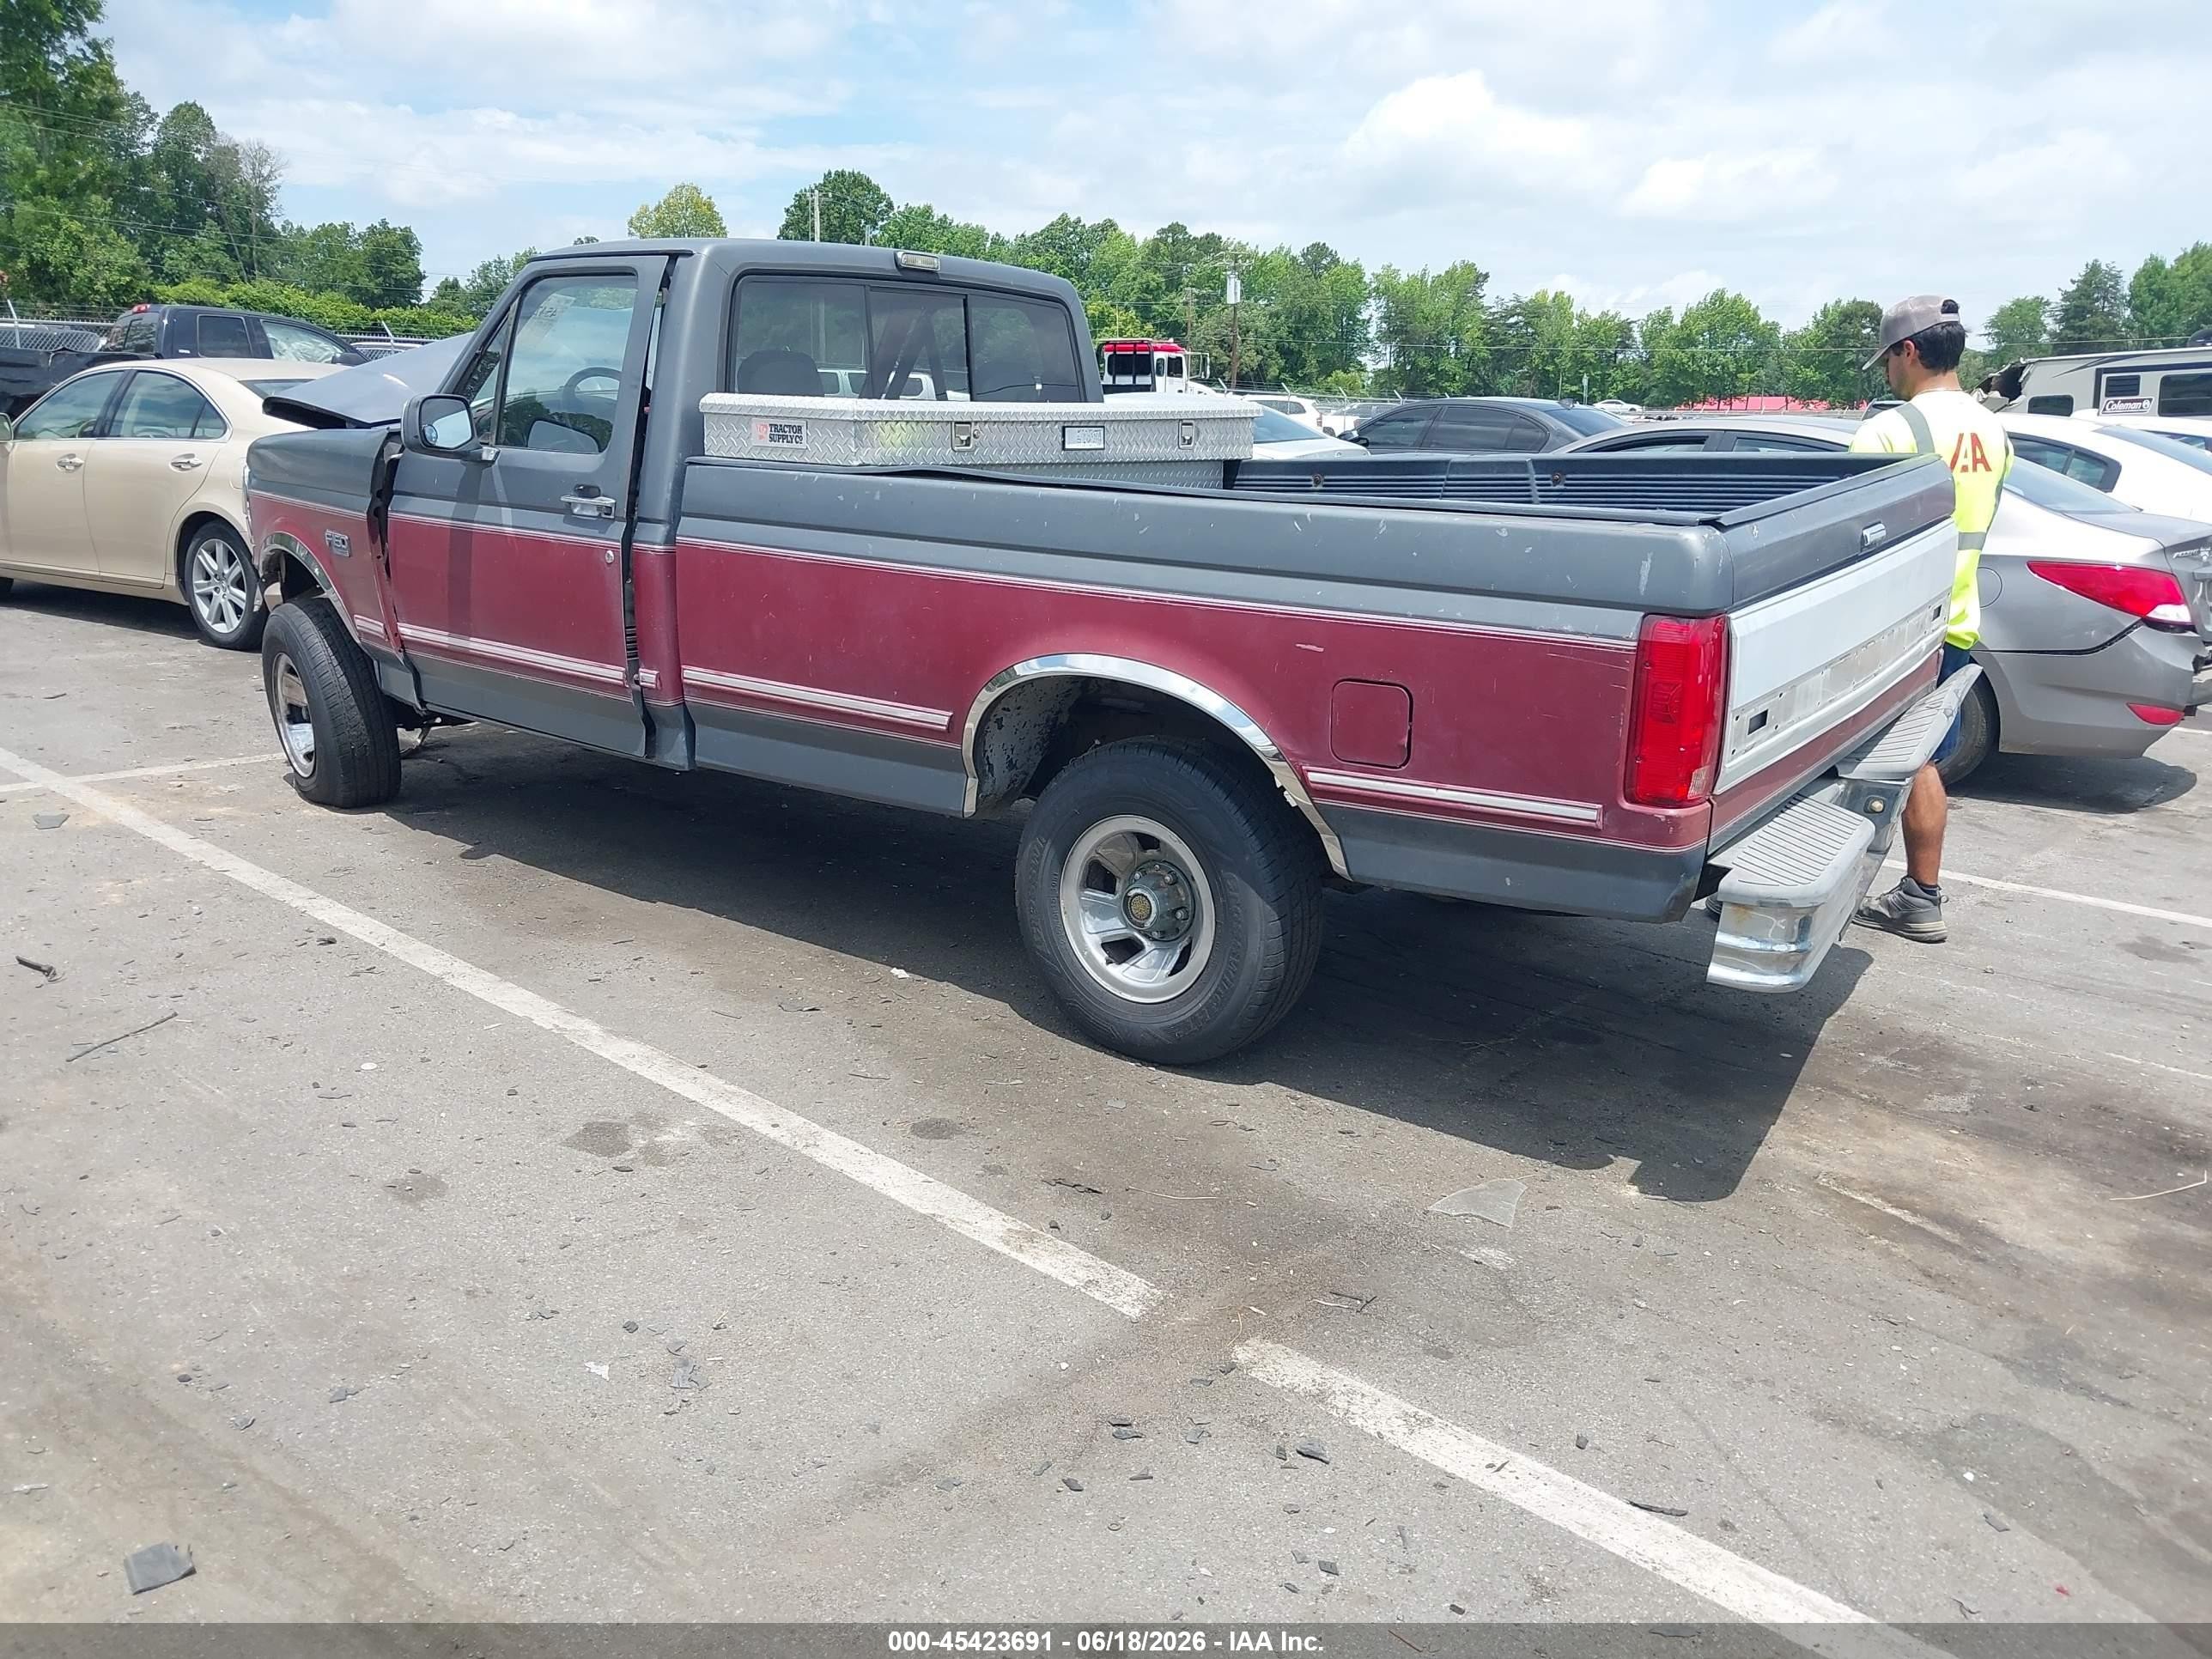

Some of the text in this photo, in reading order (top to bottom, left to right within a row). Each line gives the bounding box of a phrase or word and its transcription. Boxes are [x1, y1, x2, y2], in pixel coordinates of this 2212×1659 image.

[2106, 399, 2142, 410] Coleman
[769, 423, 803, 434] TRACTOR
[769, 434, 794, 444] SUPPLY
